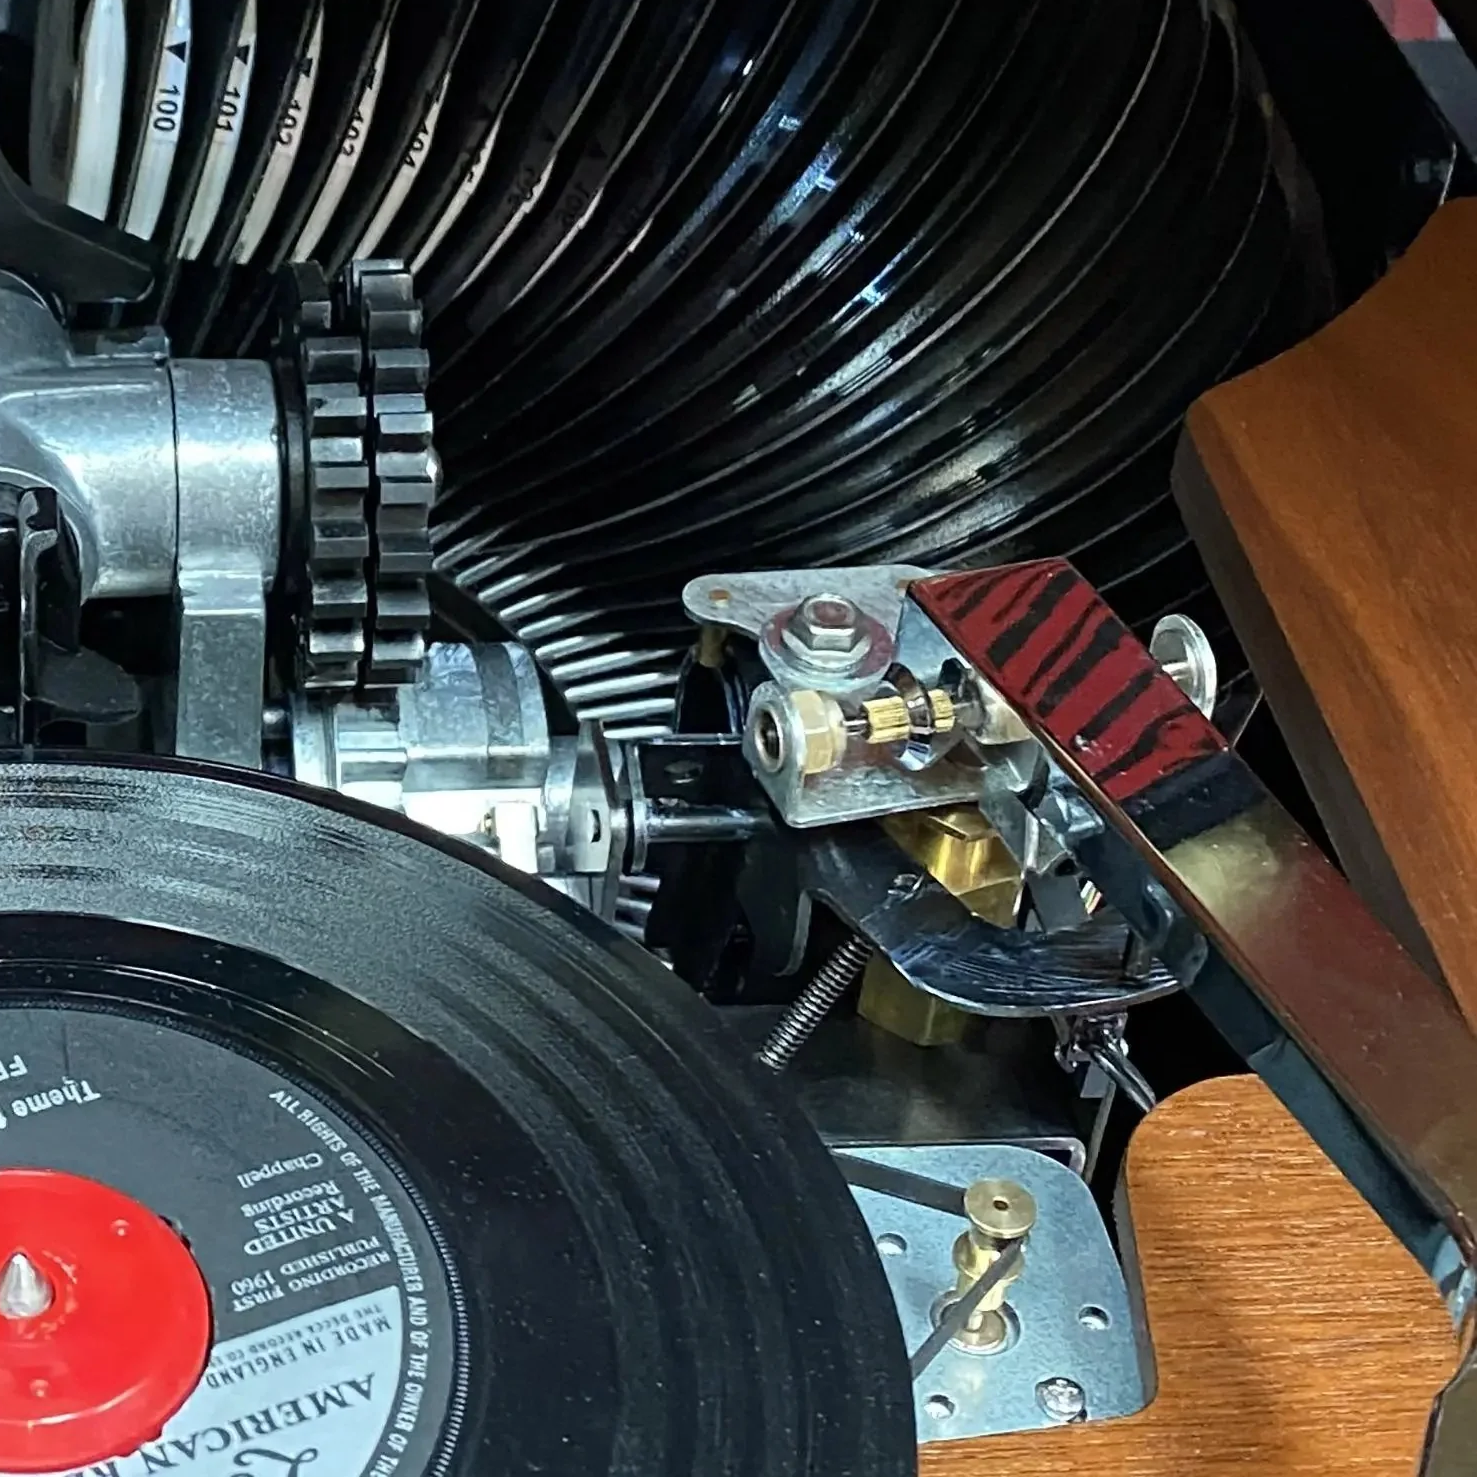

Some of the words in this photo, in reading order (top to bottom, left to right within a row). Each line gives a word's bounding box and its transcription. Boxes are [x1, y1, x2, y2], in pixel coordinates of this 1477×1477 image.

[153, 85, 180, 132] 100
[216, 87, 241, 132] 101
[11, 1079, 101, 1117] Theme
[268, 1090, 301, 1120] ALL
[297, 1109, 347, 1152] RIGHTS
[237, 1153, 323, 1188] Chappell
[340, 1151, 362, 1167] OF
[352, 1166, 381, 1193] THE
[240, 1180, 341, 1217] Recording
[254, 1195, 345, 1234] ARTISTS
[337, 1208, 354, 1224] A
[243, 1217, 336, 1255] UNITED
[370, 1194, 424, 1292] MANUFACTURER
[280, 1236, 380, 1276] PUBLISHED
[288, 1250, 391, 1292] RECORDING
[231, 1269, 276, 1296] 1960
[232, 1285, 284, 1312] FIRST
[306, 1313, 349, 1333] DECCA
[407, 1296, 428, 1326] AND
[249, 1330, 302, 1353] RECORD
[301, 1337, 326, 1356] IN
[331, 1316, 392, 1346] MADE
[409, 1331, 429, 1348] OF
[206, 1347, 297, 1389] ENGLAND
[407, 1351, 428, 1380] THE
[394, 1381, 424, 1432] OWNER
[137, 1372, 375, 1475] AMERICAN
[386, 1432, 408, 1452] OF
